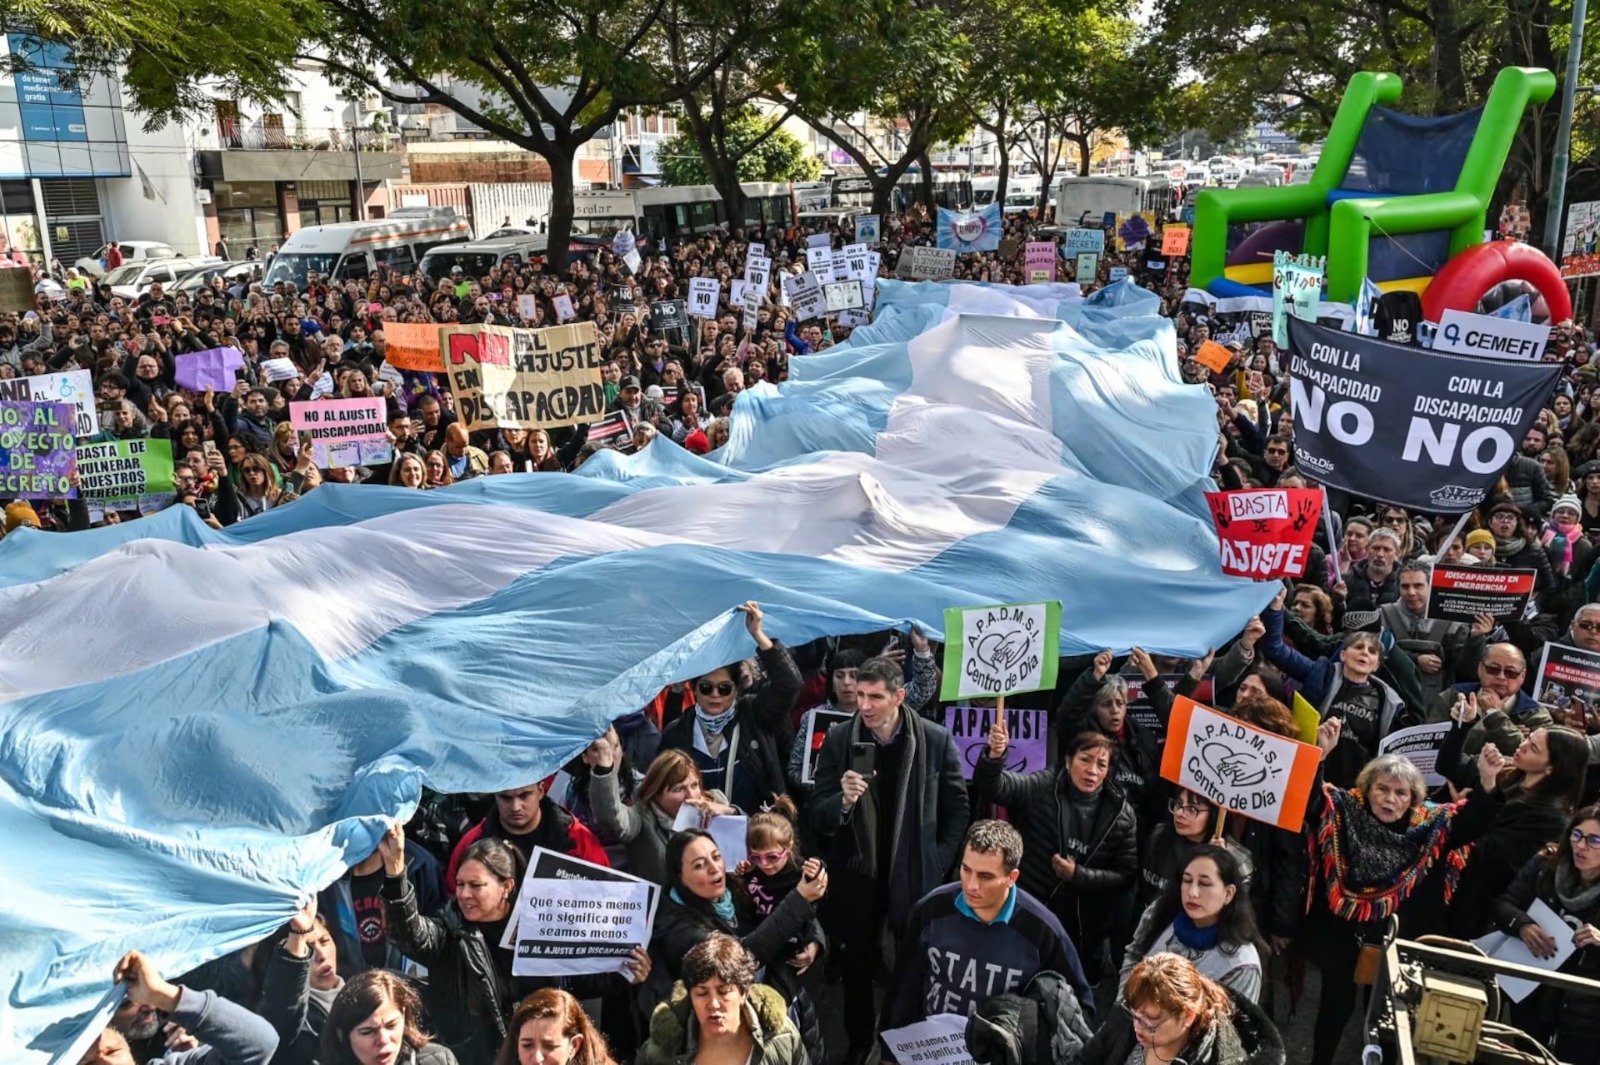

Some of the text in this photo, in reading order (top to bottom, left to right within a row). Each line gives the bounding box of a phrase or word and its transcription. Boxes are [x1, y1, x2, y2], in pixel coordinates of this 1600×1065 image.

[24, 94, 46, 102] gratis
[576, 204, 612, 214] scolar
[1068, 240, 1099, 249] DECRETO
[851, 259, 864, 271] NO
[750, 272, 763, 284] NO
[696, 293, 710, 304] NO
[662, 306, 676, 315] NO
[1393, 319, 1409, 332] NO
[450, 332, 510, 366] NO
[516, 333, 547, 351] AL
[1464, 331, 1540, 359] CEMEFI
[516, 343, 599, 372] AJUSTE
[1310, 342, 1361, 372] CON LA
[454, 369, 480, 391] EN
[1448, 376, 1504, 398] CON LA
[34, 391, 46, 400] AL
[34, 408, 59, 426] AL
[304, 408, 377, 422] NO AL AJUSTE
[1290, 375, 1374, 446] NO
[1413, 395, 1523, 426] DISCAPACIDAD
[0, 432, 74, 450] OYECTO
[1402, 416, 1514, 474] NO
[77, 441, 145, 460] BASTA DE
[10, 454, 36, 470] DE
[77, 458, 140, 474] VULNERAR
[0, 475, 70, 493] ECRETO
[80, 472, 145, 489] NUESTROS
[80, 484, 145, 498] DERECHOS
[1231, 494, 1287, 517] BASTA
[1251, 520, 1271, 533] DE
[1221, 538, 1304, 574] AJUSTE
[968, 607, 1040, 648] A.P.A.D.M.S.I.
[966, 654, 1038, 693] Centro de Día
[953, 708, 1040, 740] APAMSI
[1193, 723, 1283, 779] A.P.A.D.M.S.I.
[1188, 756, 1276, 810] Centro de Día
[530, 897, 642, 911] Que seamos menos
[538, 912, 632, 925] no significa que
[539, 927, 628, 939] seamos menos
[520, 945, 529, 953] NO
[532, 945, 542, 953] AL
[544, 946, 574, 955] AJUSTE
[576, 947, 586, 955] EN
[928, 947, 1023, 996] STATE
[896, 1042, 914, 1052] Que
[916, 1036, 949, 1048] seamos
[912, 1047, 962, 1062] no significa
